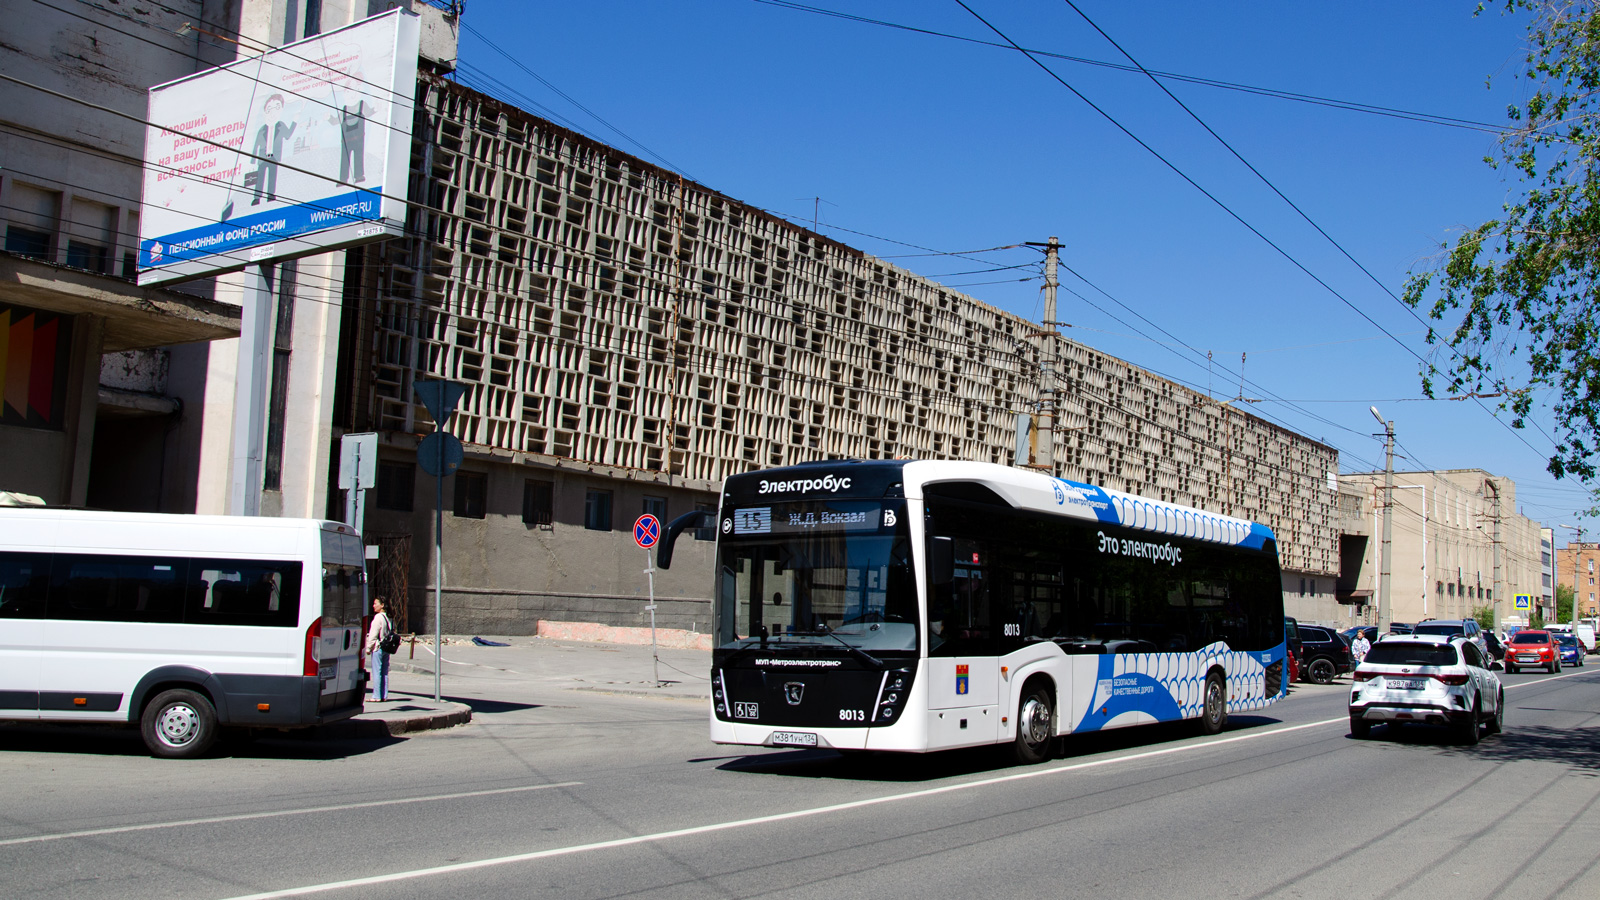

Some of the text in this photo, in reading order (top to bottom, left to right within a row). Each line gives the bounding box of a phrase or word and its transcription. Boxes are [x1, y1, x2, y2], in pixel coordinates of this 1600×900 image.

[160, 113, 208, 137] Хороший
[173, 120, 245, 151] работодатель
[158, 135, 243, 166] на вашу пенсию
[157, 158, 217, 182] все взносы
[202, 163, 242, 184] платит!
[310, 200, 372, 224] WWW.PFRF.RU
[169, 219, 286, 255] ПЕНСИОННЫЙ ФОНД РОССИИ
[758, 474, 852, 494] Электробус
[741, 512, 762, 531] 15
[820, 511, 866, 525] Вокзал
[1097, 530, 1182, 566] Это электробус
[1004, 623, 1020, 636] 8013
[755, 658, 842, 668] МУП «Метроэлектротранс»
[839, 709, 865, 721] 8013
